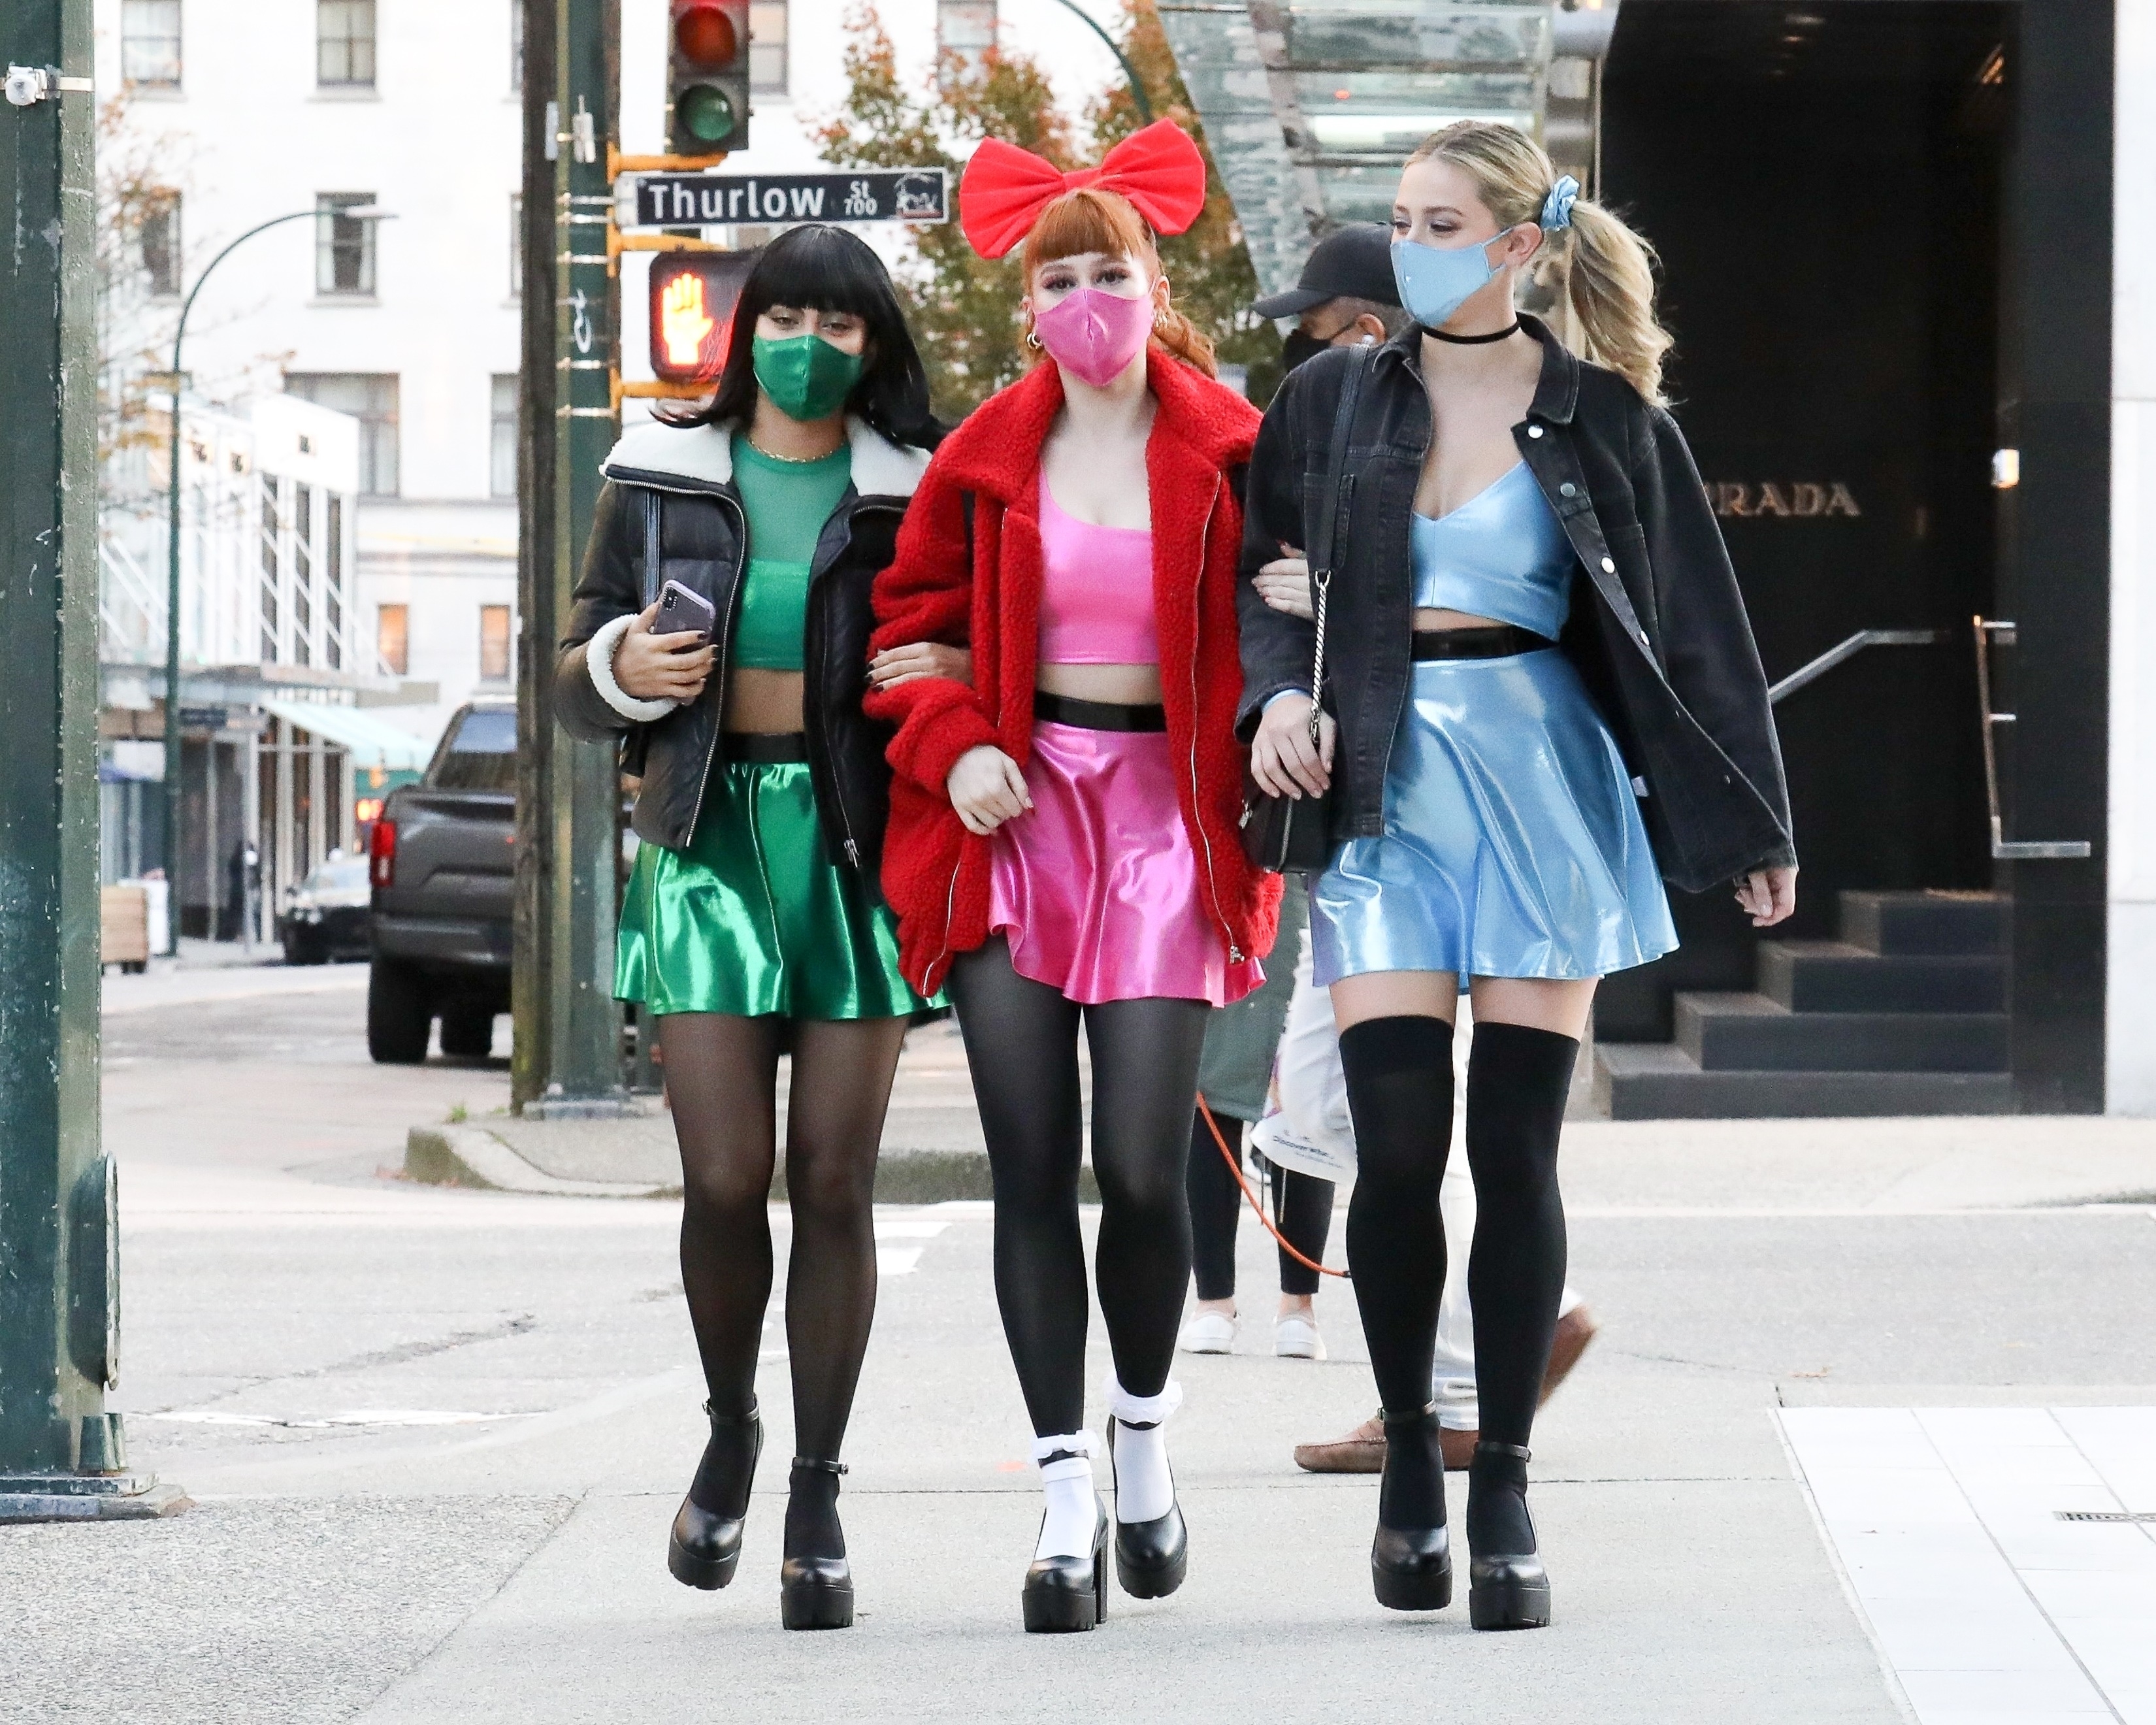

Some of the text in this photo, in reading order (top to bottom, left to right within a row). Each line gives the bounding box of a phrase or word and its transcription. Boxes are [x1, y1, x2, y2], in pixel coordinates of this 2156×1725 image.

[648, 180, 870, 219] Thurlow St
[843, 197, 878, 216] 700
